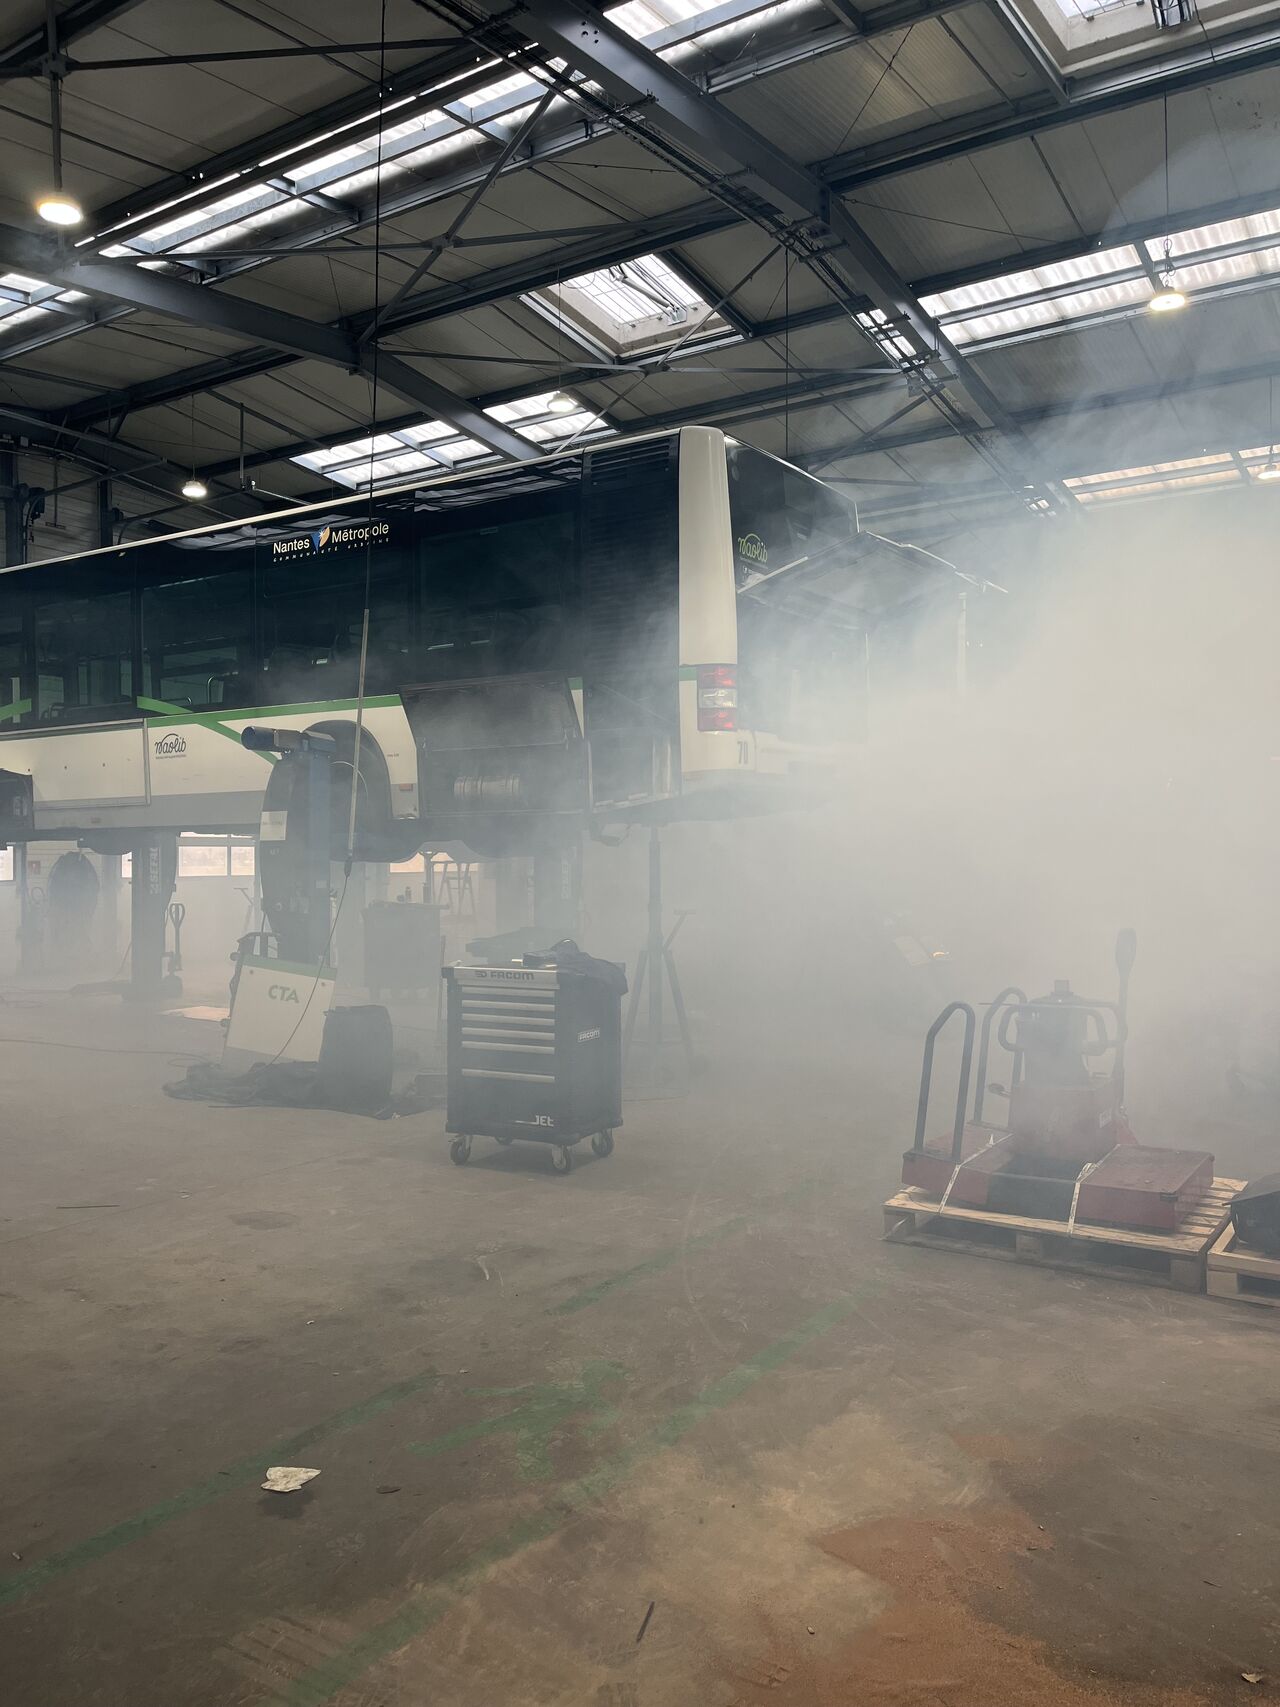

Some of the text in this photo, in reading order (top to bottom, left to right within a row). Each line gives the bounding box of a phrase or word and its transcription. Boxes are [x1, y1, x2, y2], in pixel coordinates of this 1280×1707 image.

[273, 522, 389, 554] Nantes Métropole
[490, 971, 535, 980] FACOM
[268, 984, 299, 1003] CTA
